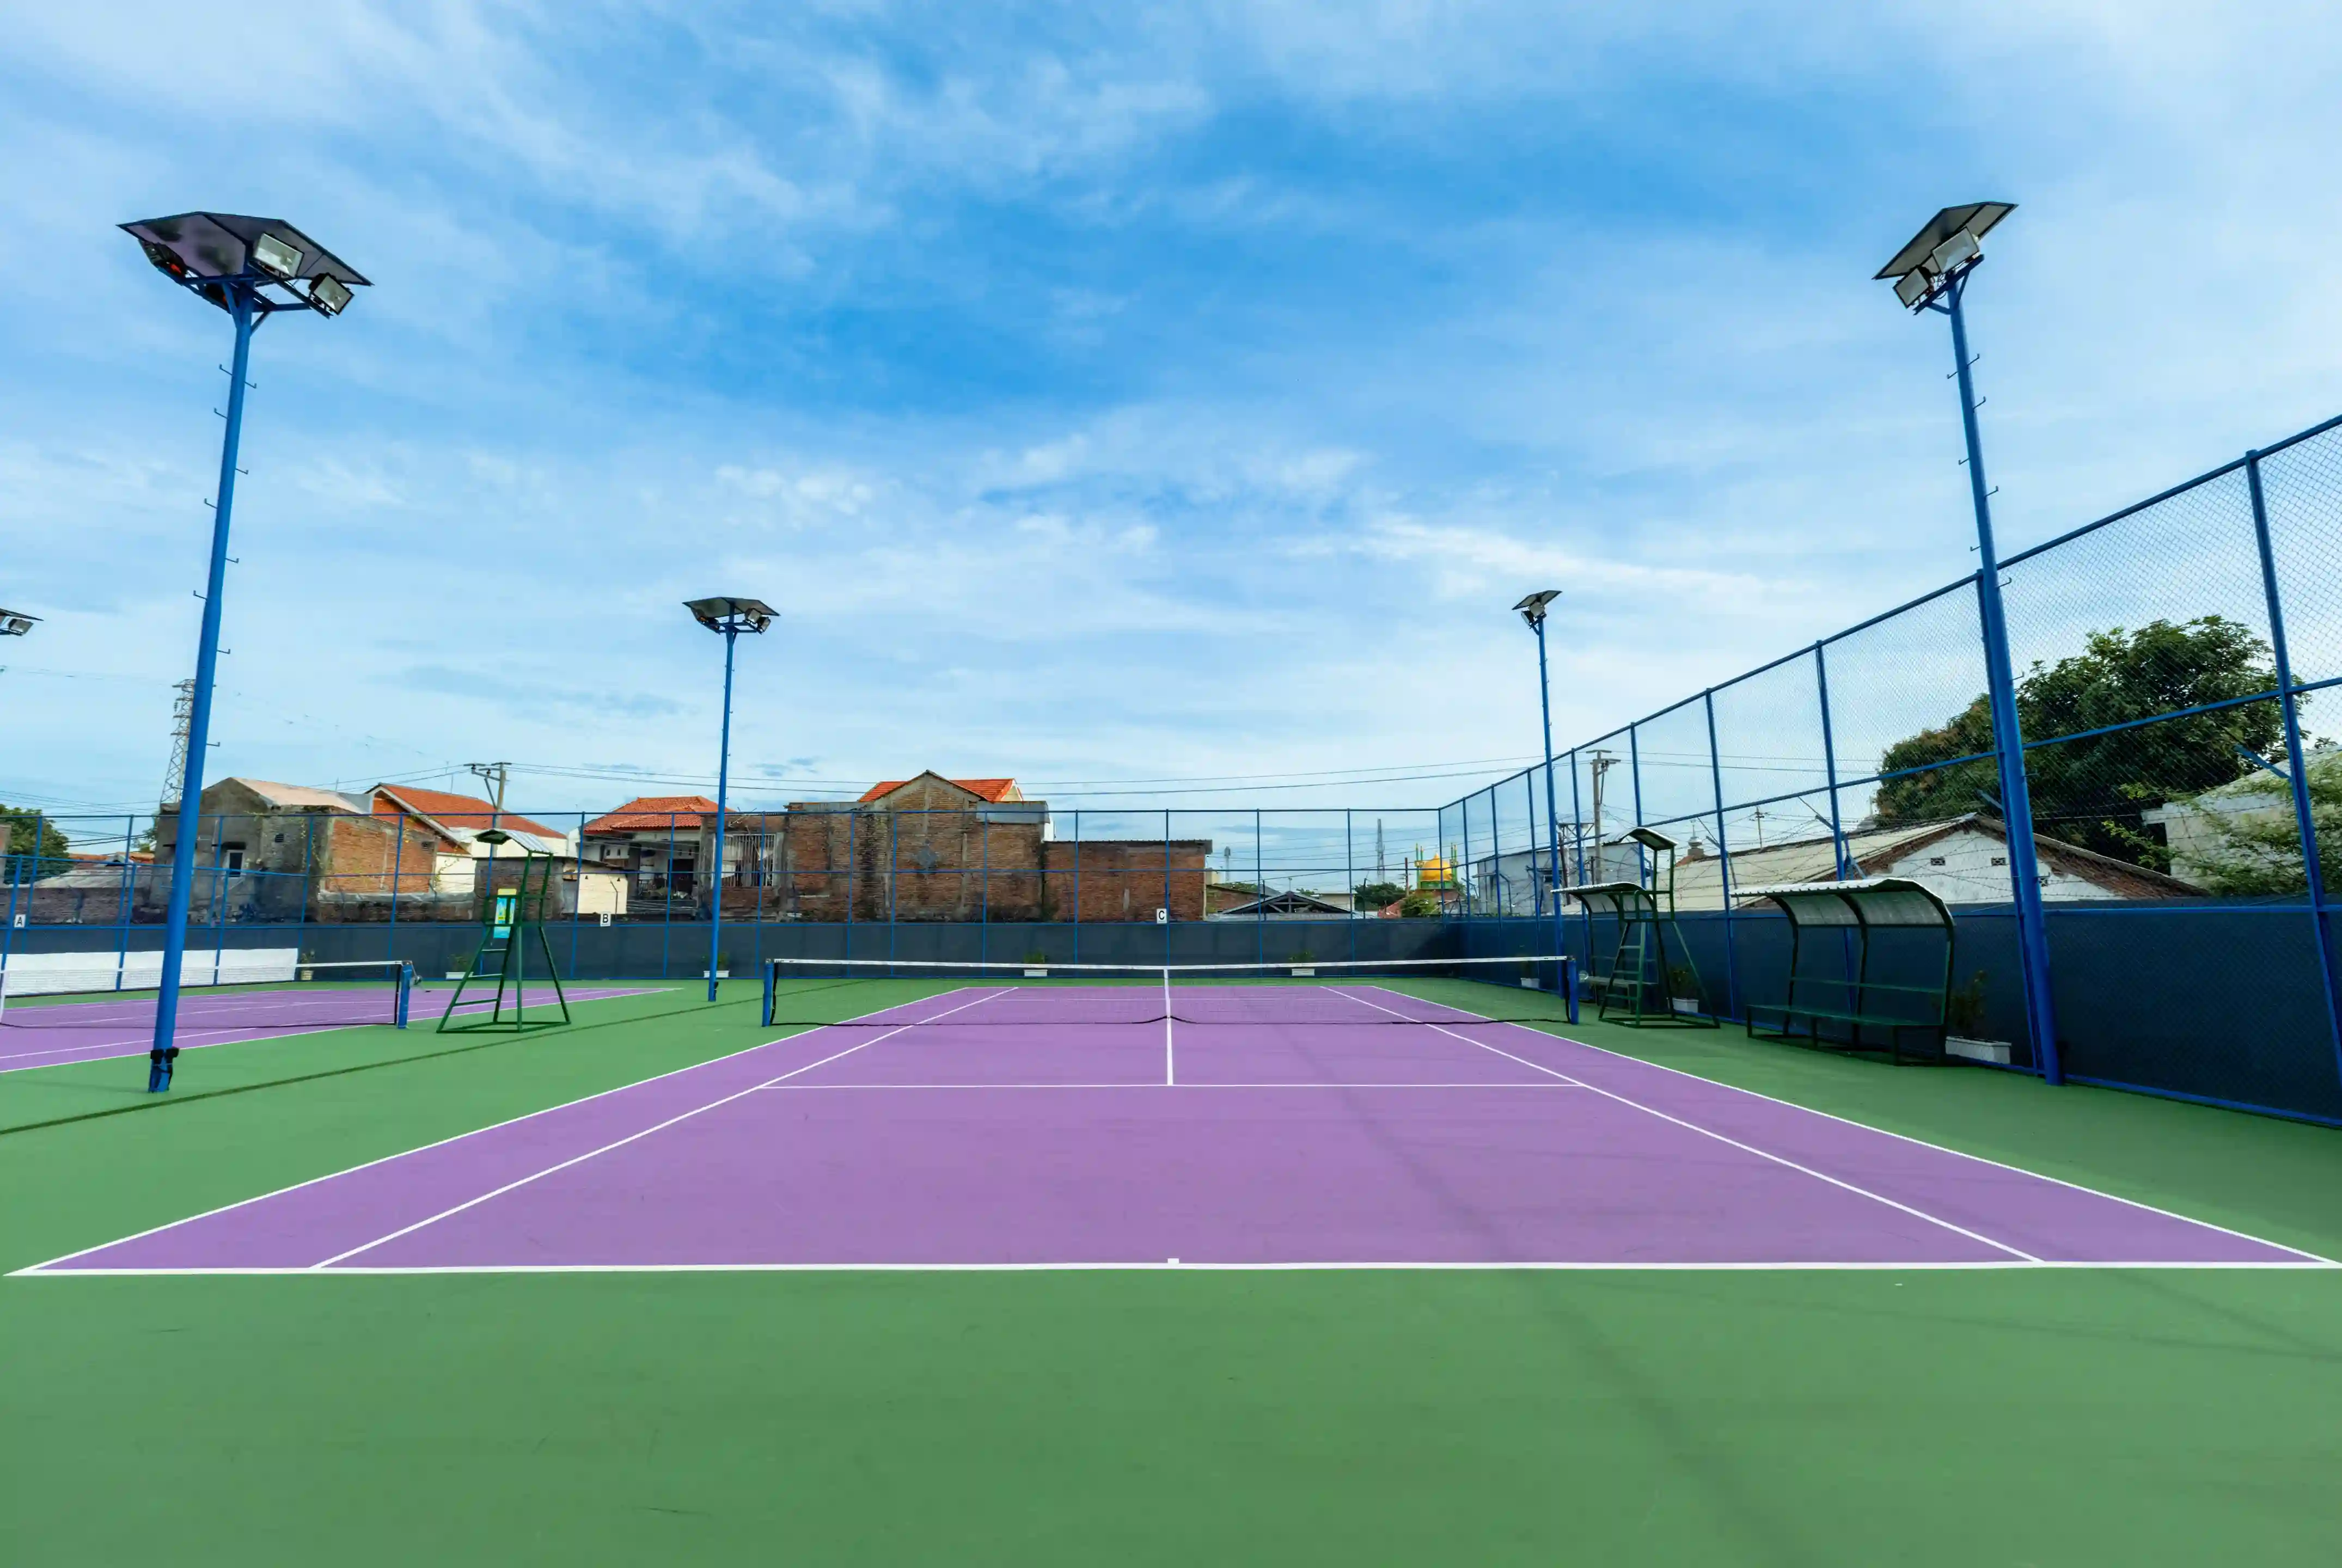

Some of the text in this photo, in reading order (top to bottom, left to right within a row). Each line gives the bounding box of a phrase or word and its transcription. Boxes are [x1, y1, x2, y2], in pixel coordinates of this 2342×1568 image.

[603, 914, 608, 923] B
[1159, 910, 1165, 920] C
[16, 916, 22, 926] A
